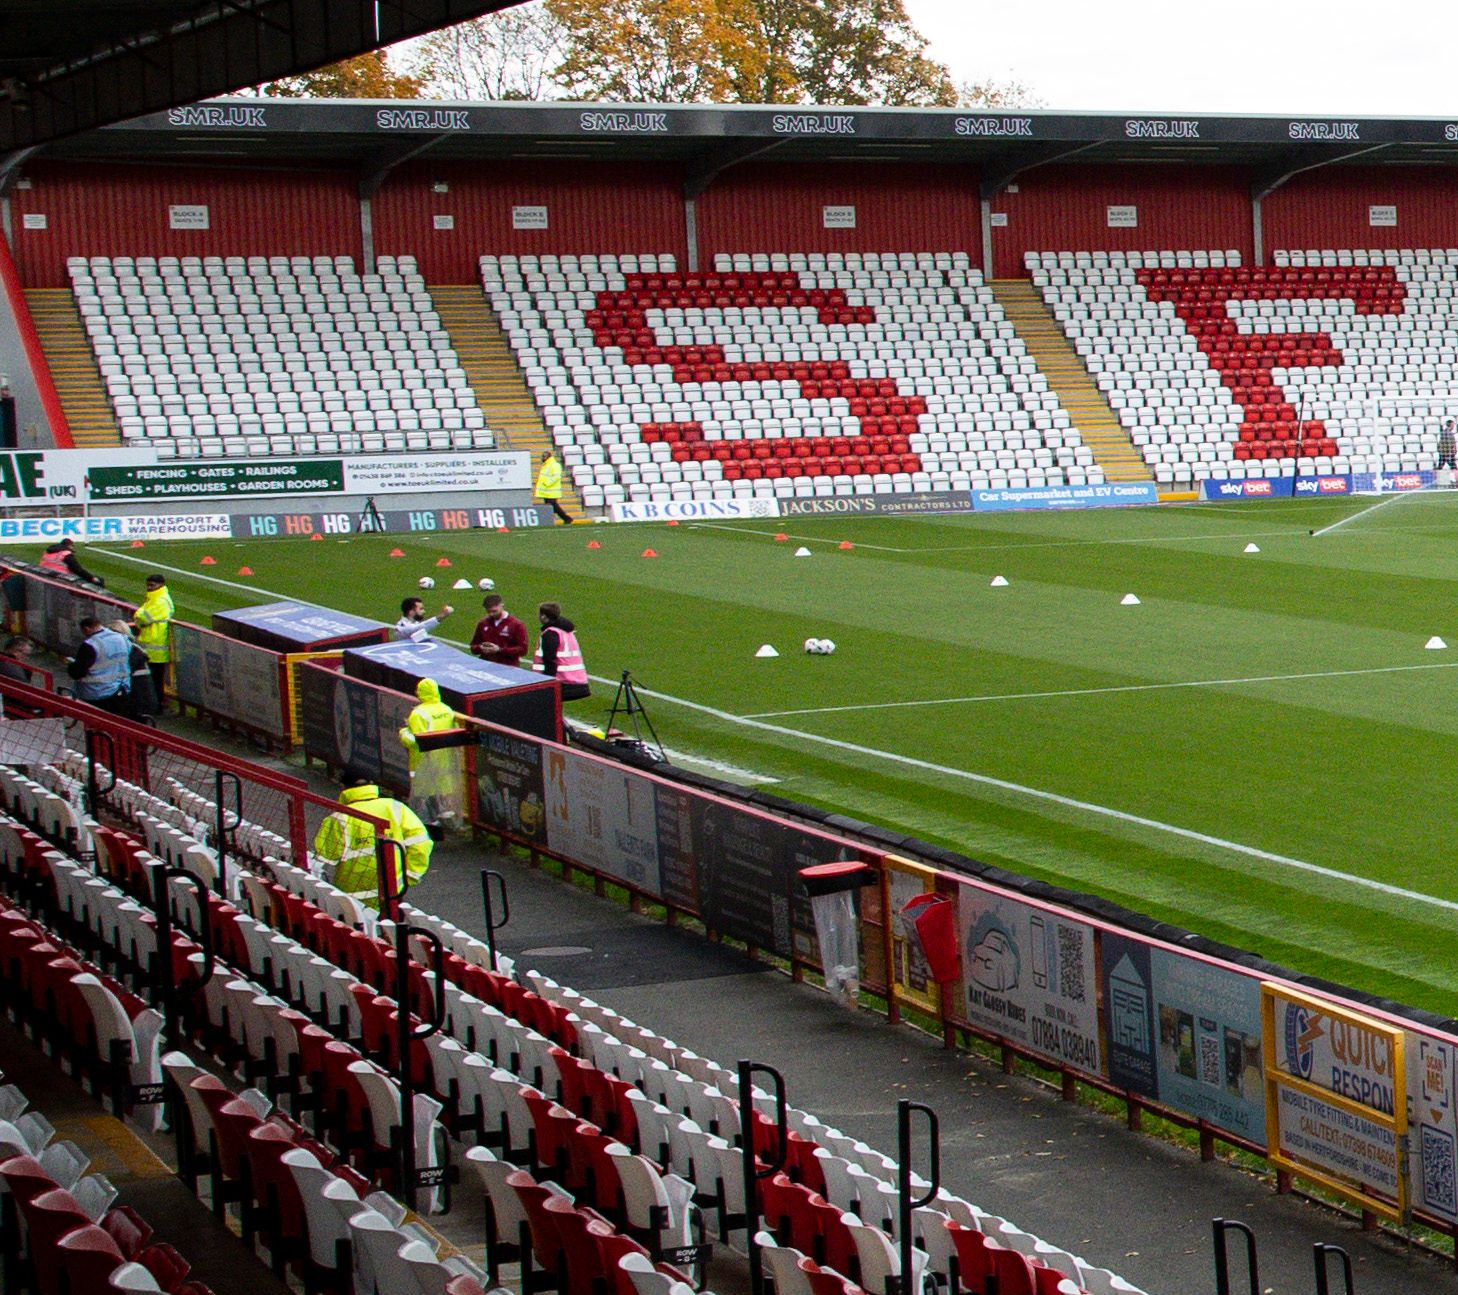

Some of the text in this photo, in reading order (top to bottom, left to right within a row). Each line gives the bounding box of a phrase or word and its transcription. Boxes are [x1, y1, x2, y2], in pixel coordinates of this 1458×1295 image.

[377, 109, 470, 129] SMR.UK
[773, 115, 854, 134] SMR.UK
[1125, 119, 1199, 138] SMR.UK
[136, 466, 297, 479] FENCING GATES RAILINGS
[105, 479, 329, 496] SHEDS PLAYHOUSES GARDEN ROOMS
[980, 485, 1149, 502] Car Supermarket and EV Centre
[1219, 481, 1269, 496] sky bet
[781, 497, 876, 517] JACKSON'S
[128, 523, 231, 533] WAREHOUSING
